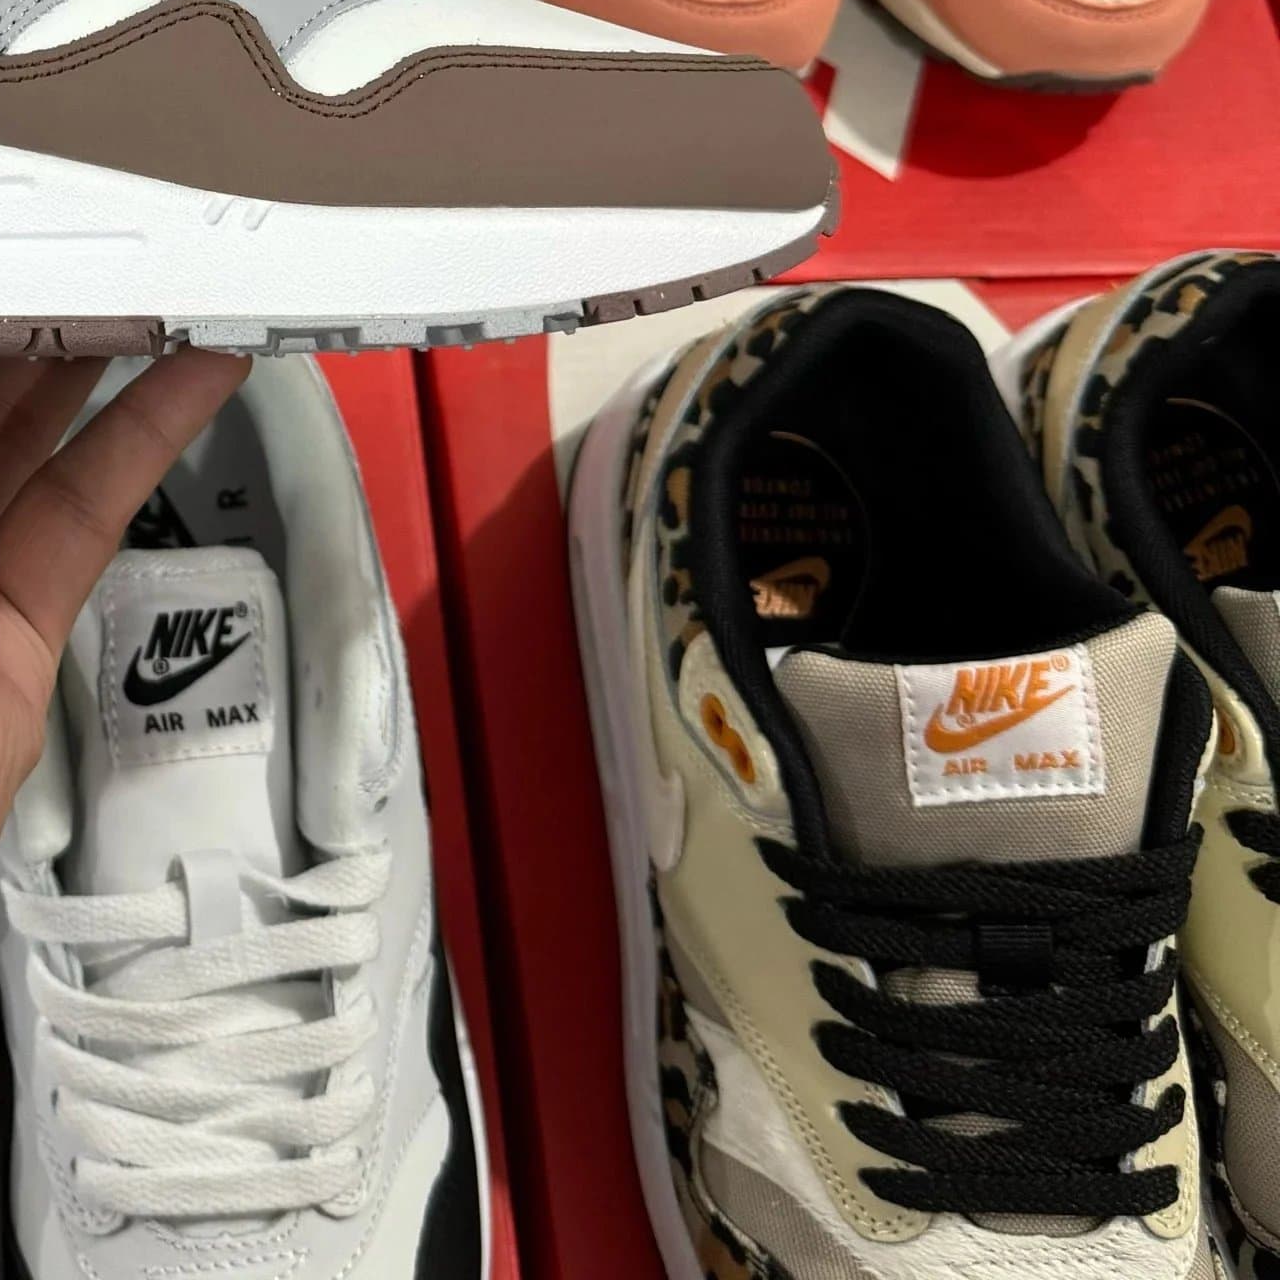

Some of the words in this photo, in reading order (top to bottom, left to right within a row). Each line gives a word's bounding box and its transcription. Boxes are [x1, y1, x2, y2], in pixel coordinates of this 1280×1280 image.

[144, 607, 234, 660] NIKE
[945, 661, 1050, 713] NIKE
[144, 712, 184, 734] AIR
[206, 702, 259, 728] MAX
[942, 758, 988, 776] AIR
[1014, 749, 1079, 770] MAX
